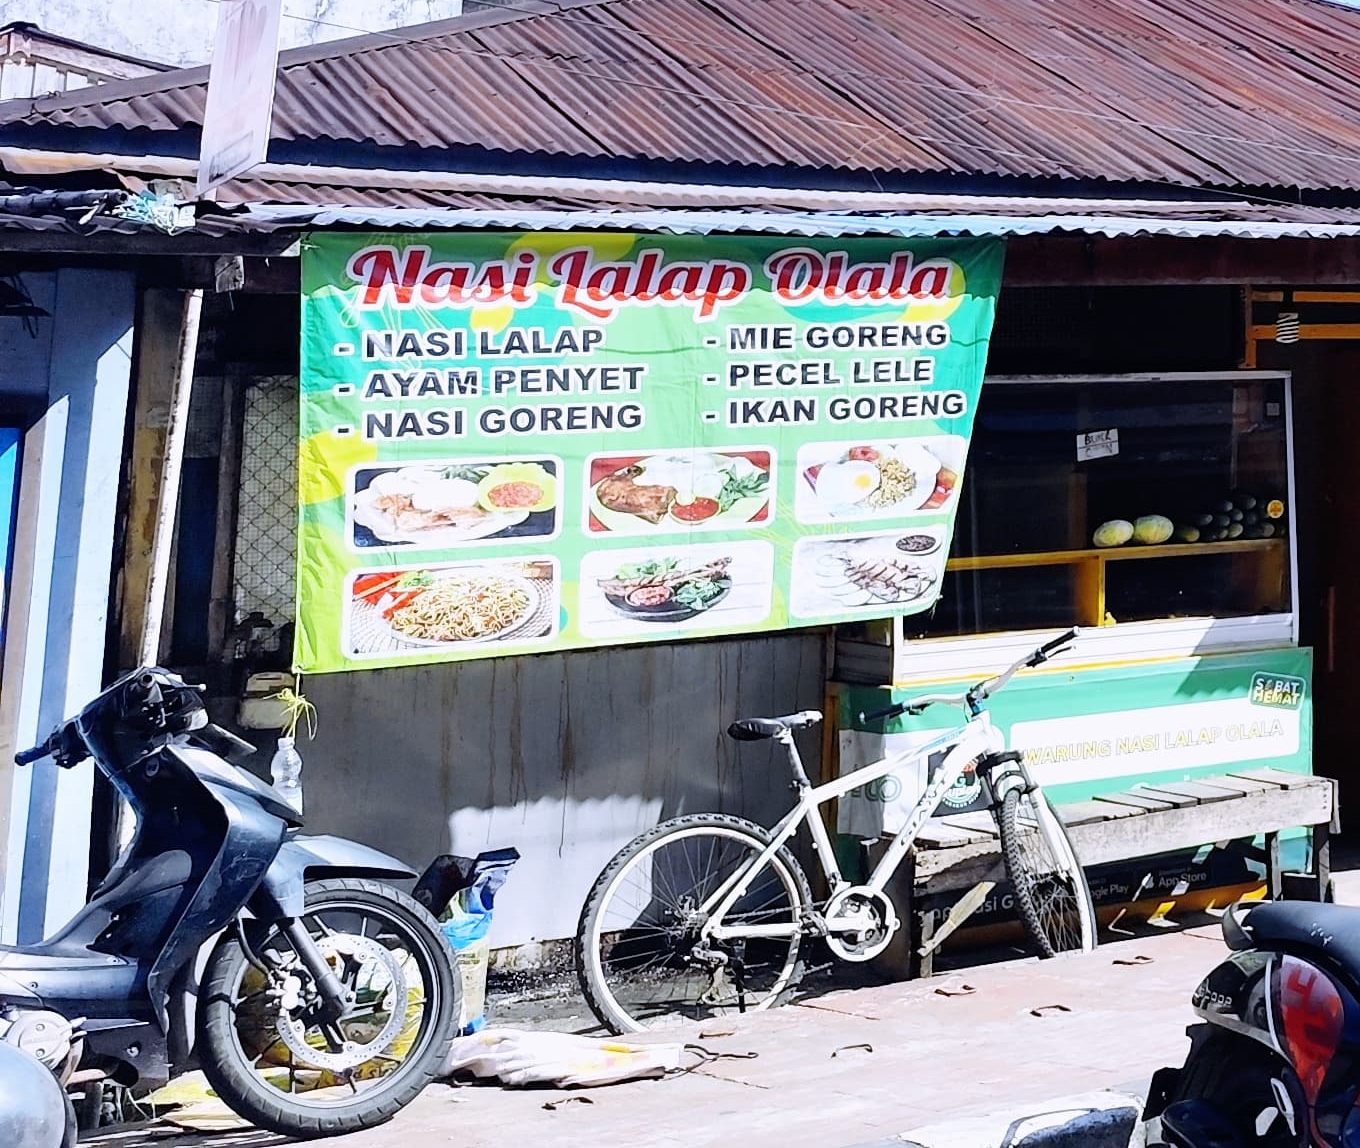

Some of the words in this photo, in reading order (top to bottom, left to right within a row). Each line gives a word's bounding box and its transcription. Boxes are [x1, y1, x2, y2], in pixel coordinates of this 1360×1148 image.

[351, 248, 533, 305] Nasi
[551, 249, 748, 319] Lalap
[768, 251, 950, 300] Olala
[366, 331, 463, 358] NASI
[480, 330, 602, 355] LALAP
[730, 327, 793, 350] MIE
[806, 324, 947, 348] GORENG
[365, 371, 478, 398] AYAM
[495, 367, 644, 393] PENYET
[730, 363, 840, 388] PECEL
[853, 359, 932, 384] LELE
[366, 410, 463, 438] NASI
[479, 405, 642, 433] GORENG
[730, 400, 815, 424] IKAN
[829, 393, 964, 421] GORENG
[1253, 689, 1300, 705] HEMAT
[1023, 738, 1112, 766] WARUNG
[1116, 733, 1161, 756] NASI
[1164, 726, 1222, 750] LALAP
[1225, 719, 1284, 743] OLALA
[1109, 884, 1129, 897] Play
[1180, 871, 1208, 884] Store
